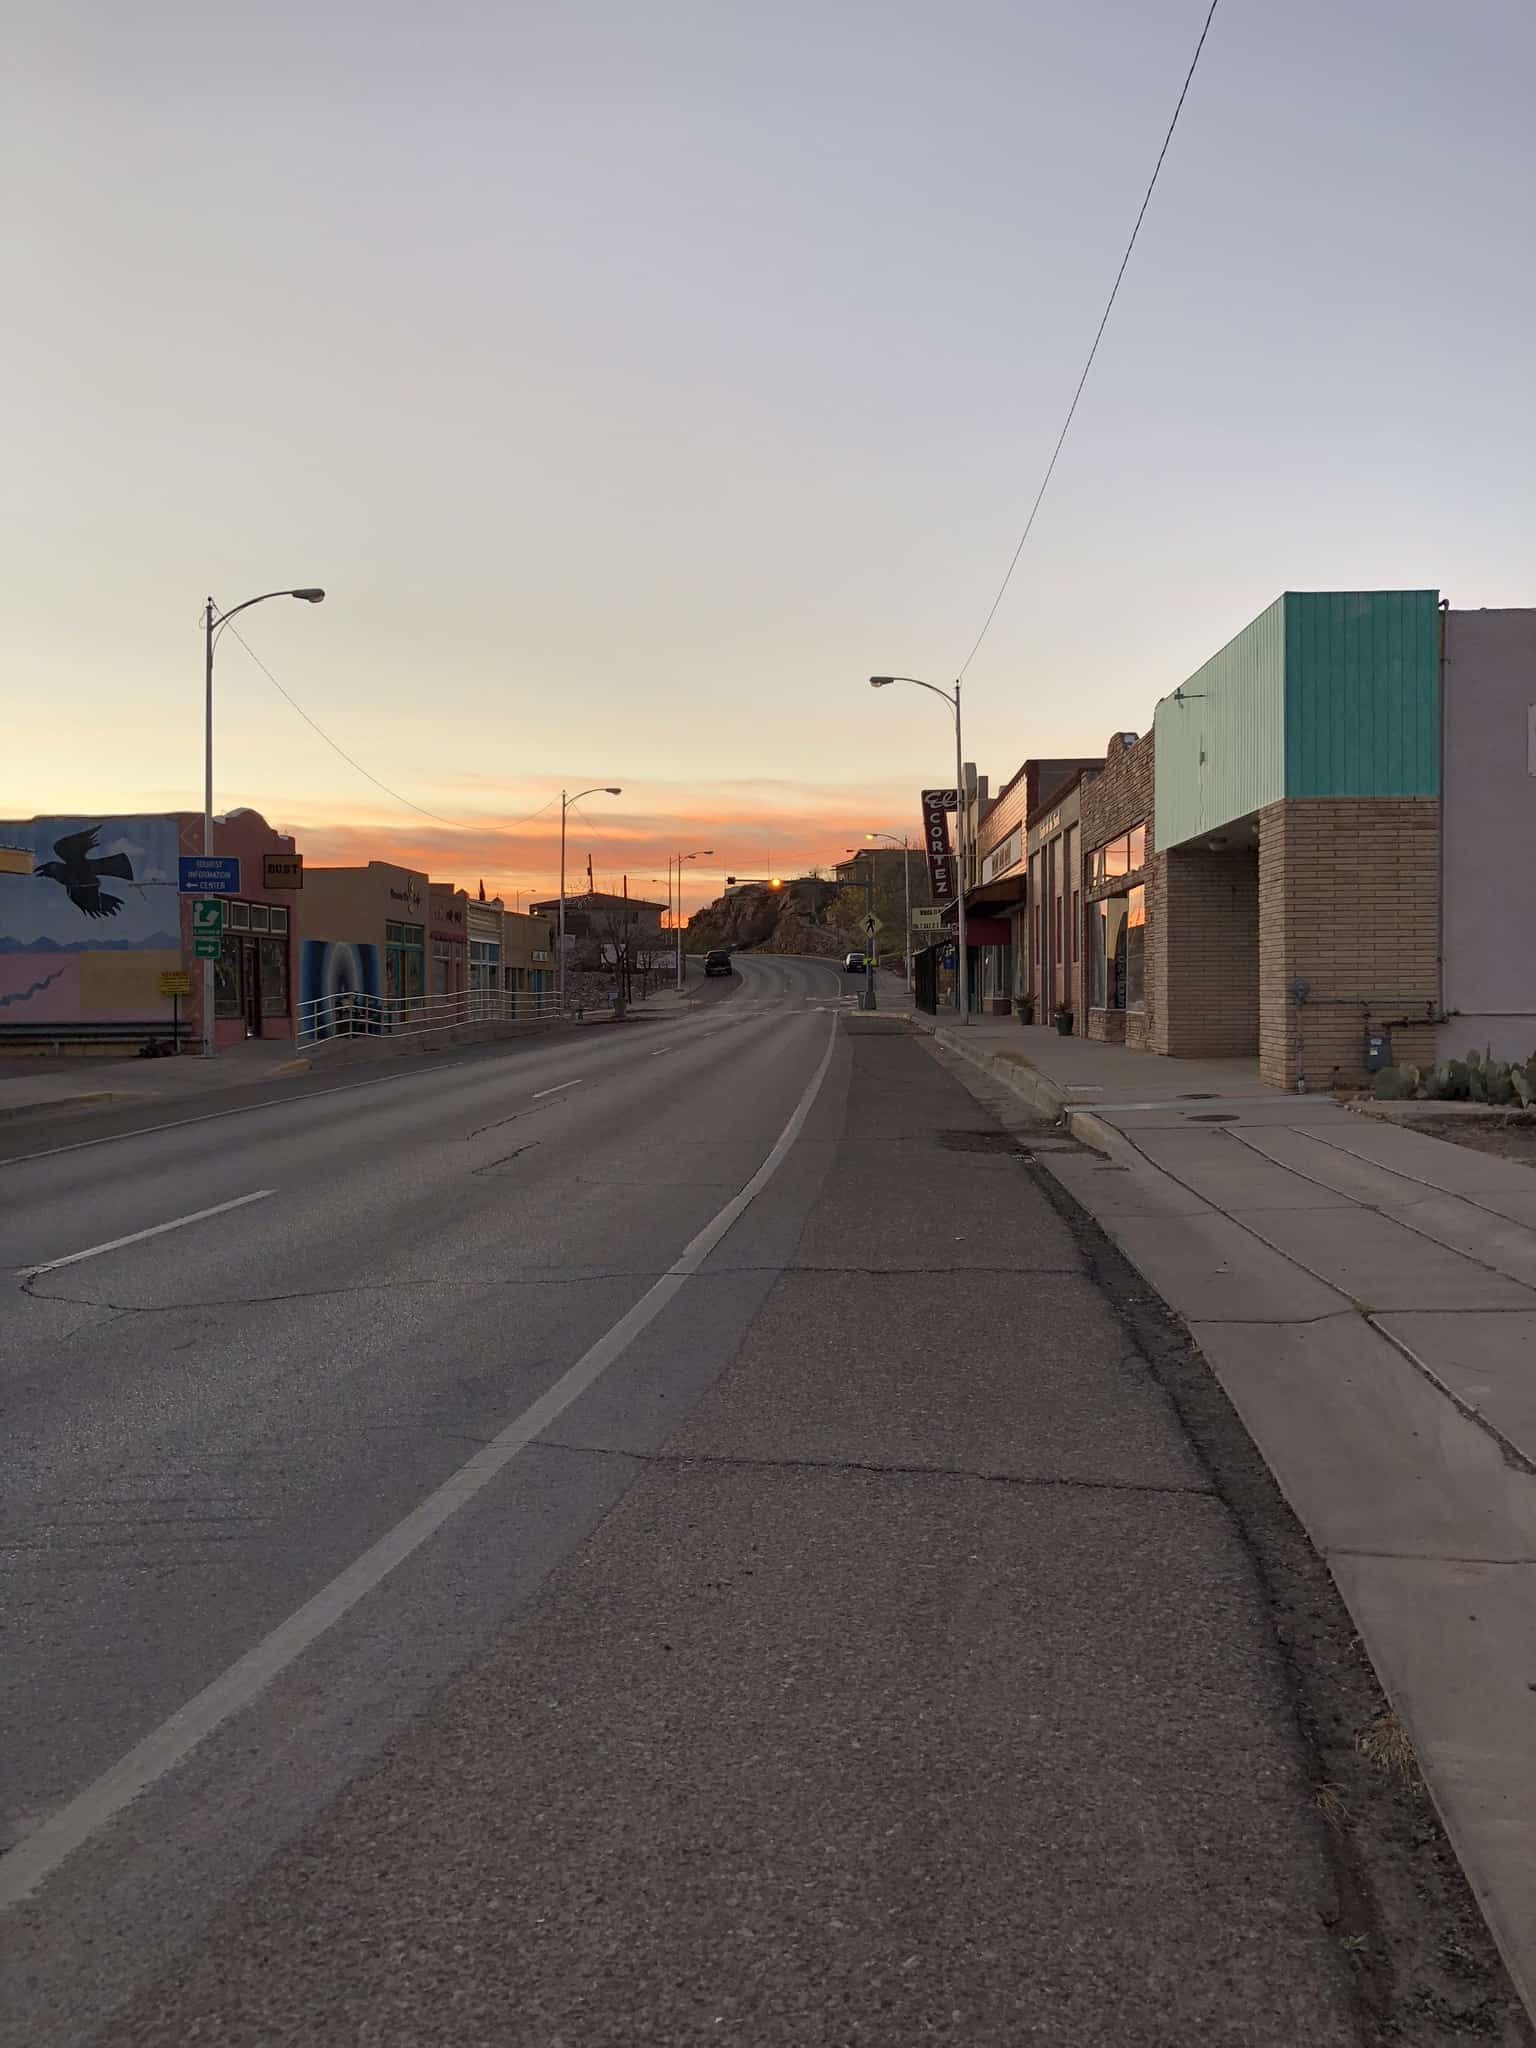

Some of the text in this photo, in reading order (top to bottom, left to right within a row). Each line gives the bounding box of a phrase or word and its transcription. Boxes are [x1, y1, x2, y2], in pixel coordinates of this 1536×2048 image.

[925, 791, 956, 809] El
[929, 812, 949, 894] CORTEZ
[188, 871, 232, 880] INFORMATION
[199, 881, 226, 890] CENTER
